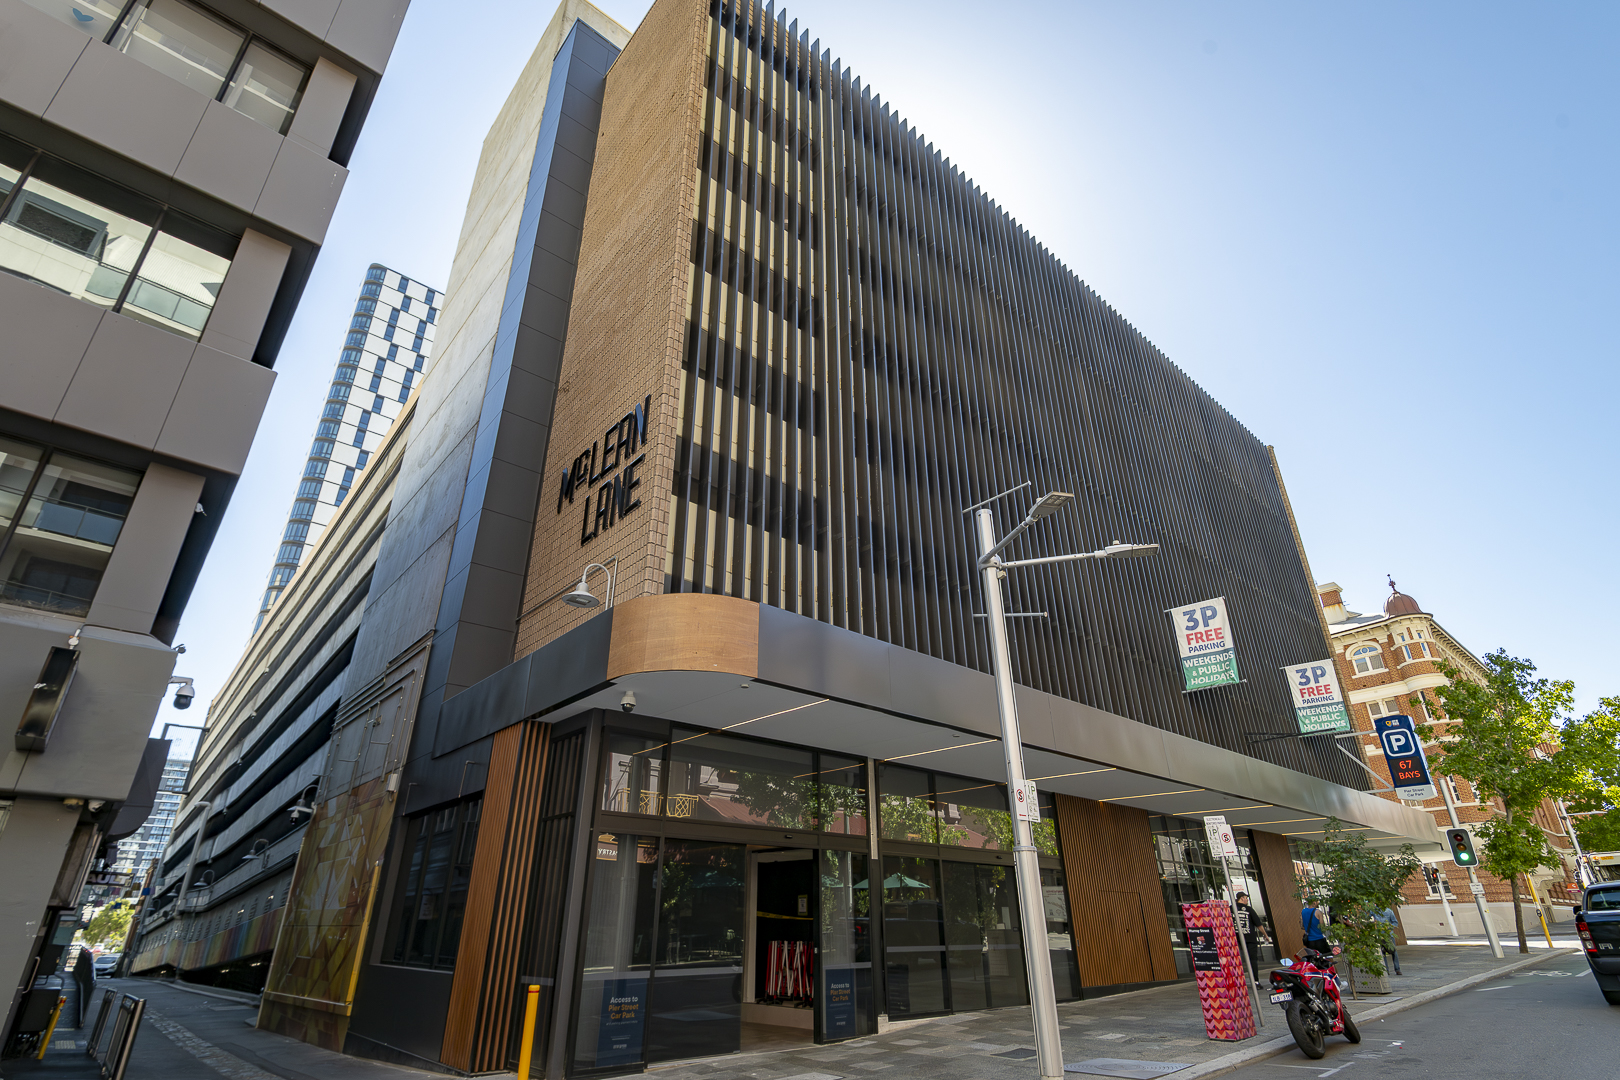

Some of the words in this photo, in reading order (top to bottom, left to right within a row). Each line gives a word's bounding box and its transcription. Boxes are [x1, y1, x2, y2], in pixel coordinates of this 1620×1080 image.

[580, 453, 645, 546] LANE
[1182, 605, 1218, 631] 3P
[1186, 627, 1224, 645] FREE
[1188, 640, 1226, 653] PARKING
[1184, 651, 1234, 668] WEEKENDS
[1198, 662, 1230, 675] PUBLIC
[1191, 670, 1235, 685] HOLIDAYS
[1295, 665, 1327, 686] 3P
[1299, 684, 1333, 698] FREE
[1302, 695, 1335, 705] PARKING
[1298, 704, 1344, 716] WEEKENDS
[1311, 713, 1341, 723] PUBLIC
[1304, 720, 1346, 731] HOLIDAYS
[1390, 734, 1405, 751] P
[1399, 760, 1412, 769] 67
[1398, 770, 1420, 779] BAYS
